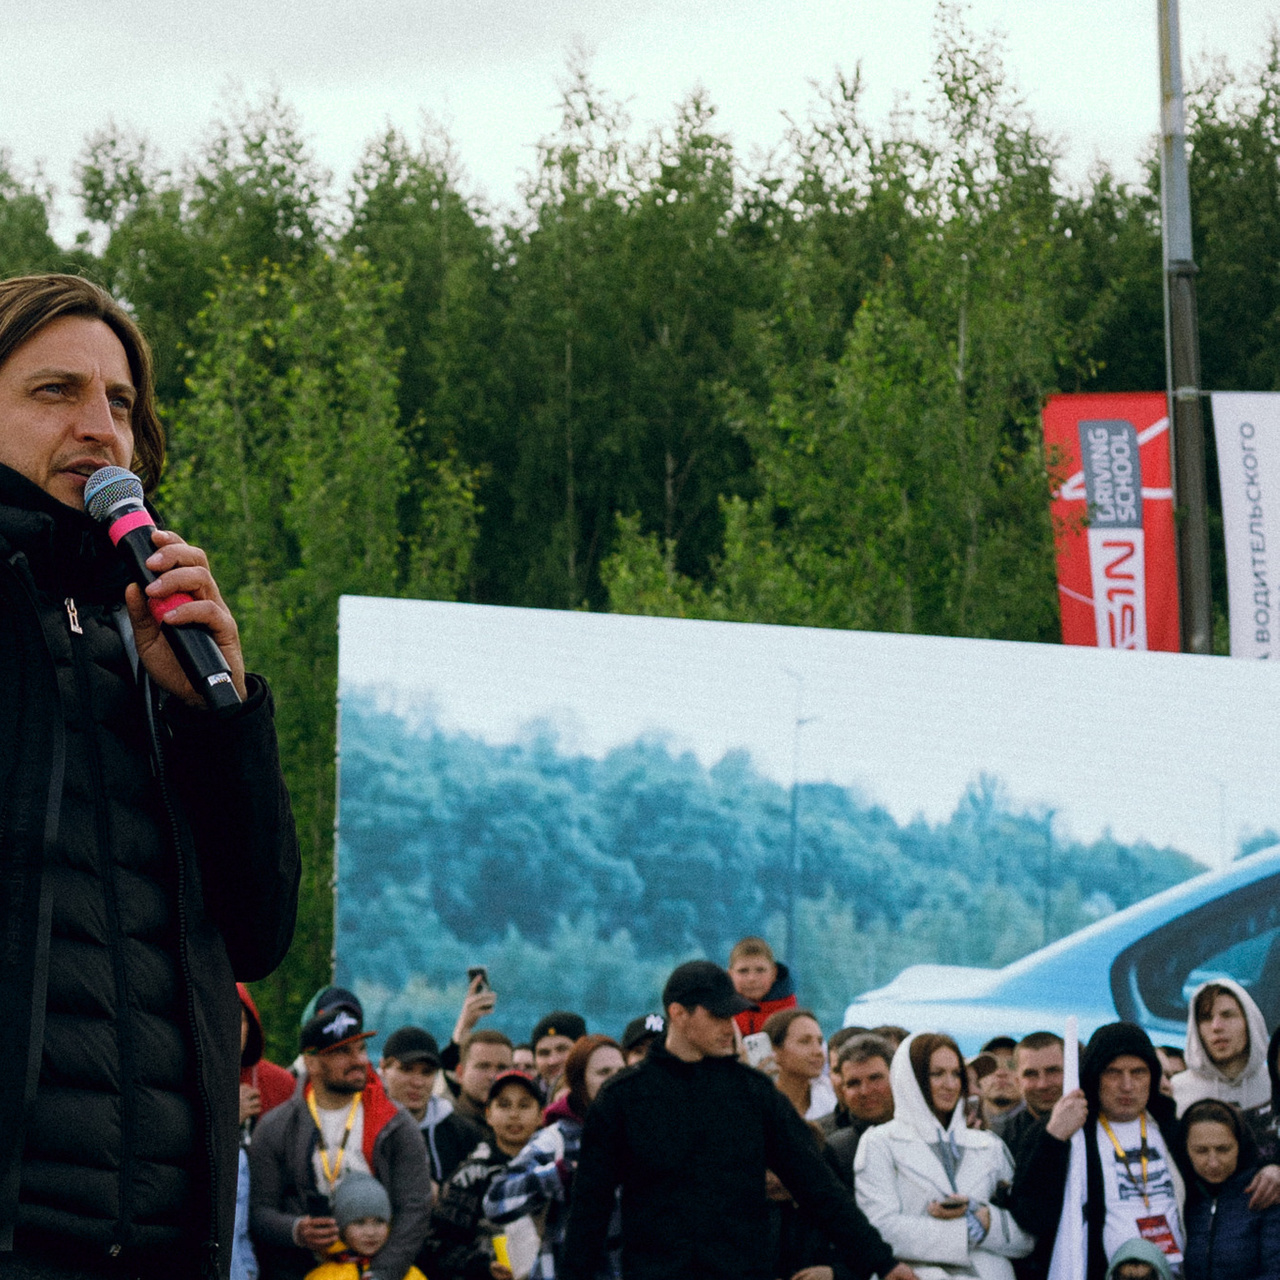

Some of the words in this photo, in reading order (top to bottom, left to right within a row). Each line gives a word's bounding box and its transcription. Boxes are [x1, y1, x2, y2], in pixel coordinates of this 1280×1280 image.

[1087, 428, 1117, 522] DRIVING
[1110, 428, 1137, 522] SCHOOL
[1239, 422, 1270, 643] ВОДИТЕЛЬСКОГО
